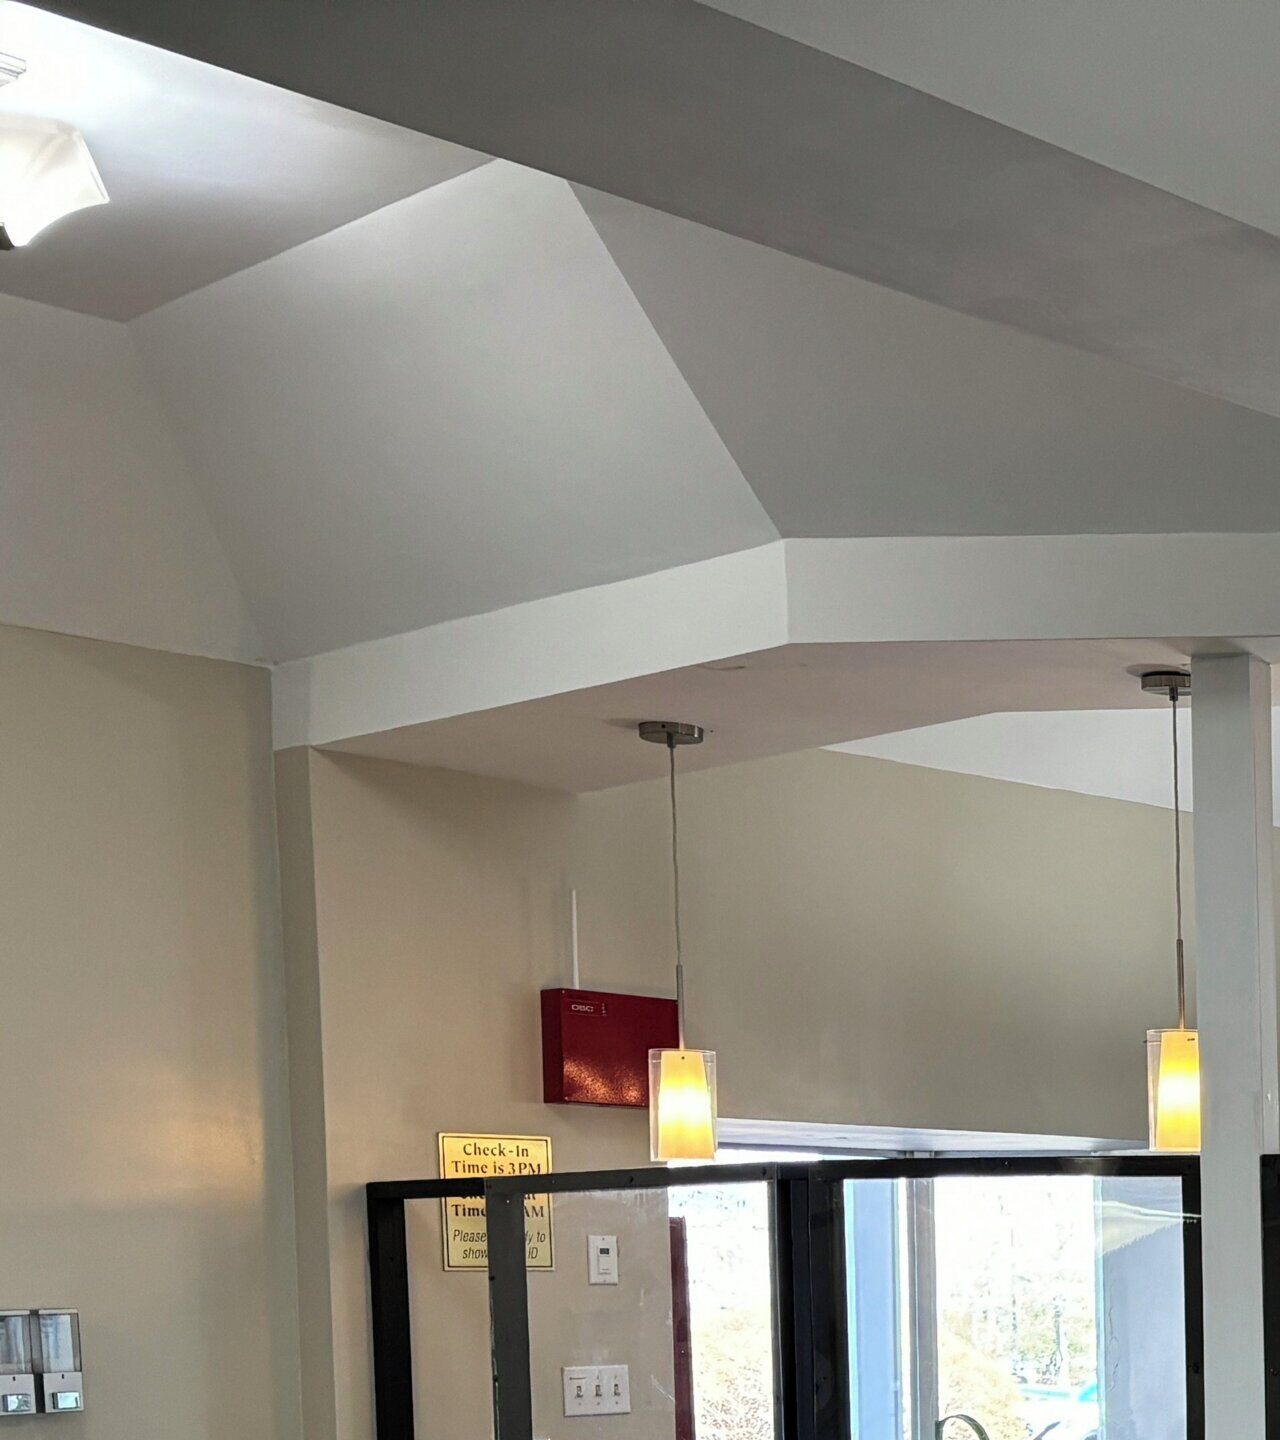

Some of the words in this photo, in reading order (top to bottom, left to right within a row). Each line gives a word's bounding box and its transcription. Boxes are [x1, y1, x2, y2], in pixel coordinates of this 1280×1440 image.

[463, 1143, 529, 1157] Check-In
[451, 1161, 488, 1174] Time
[493, 1161, 504, 1174] is
[453, 1229, 487, 1243] Please
[536, 1232, 546, 1243] to
[528, 1246, 538, 1259] ID
